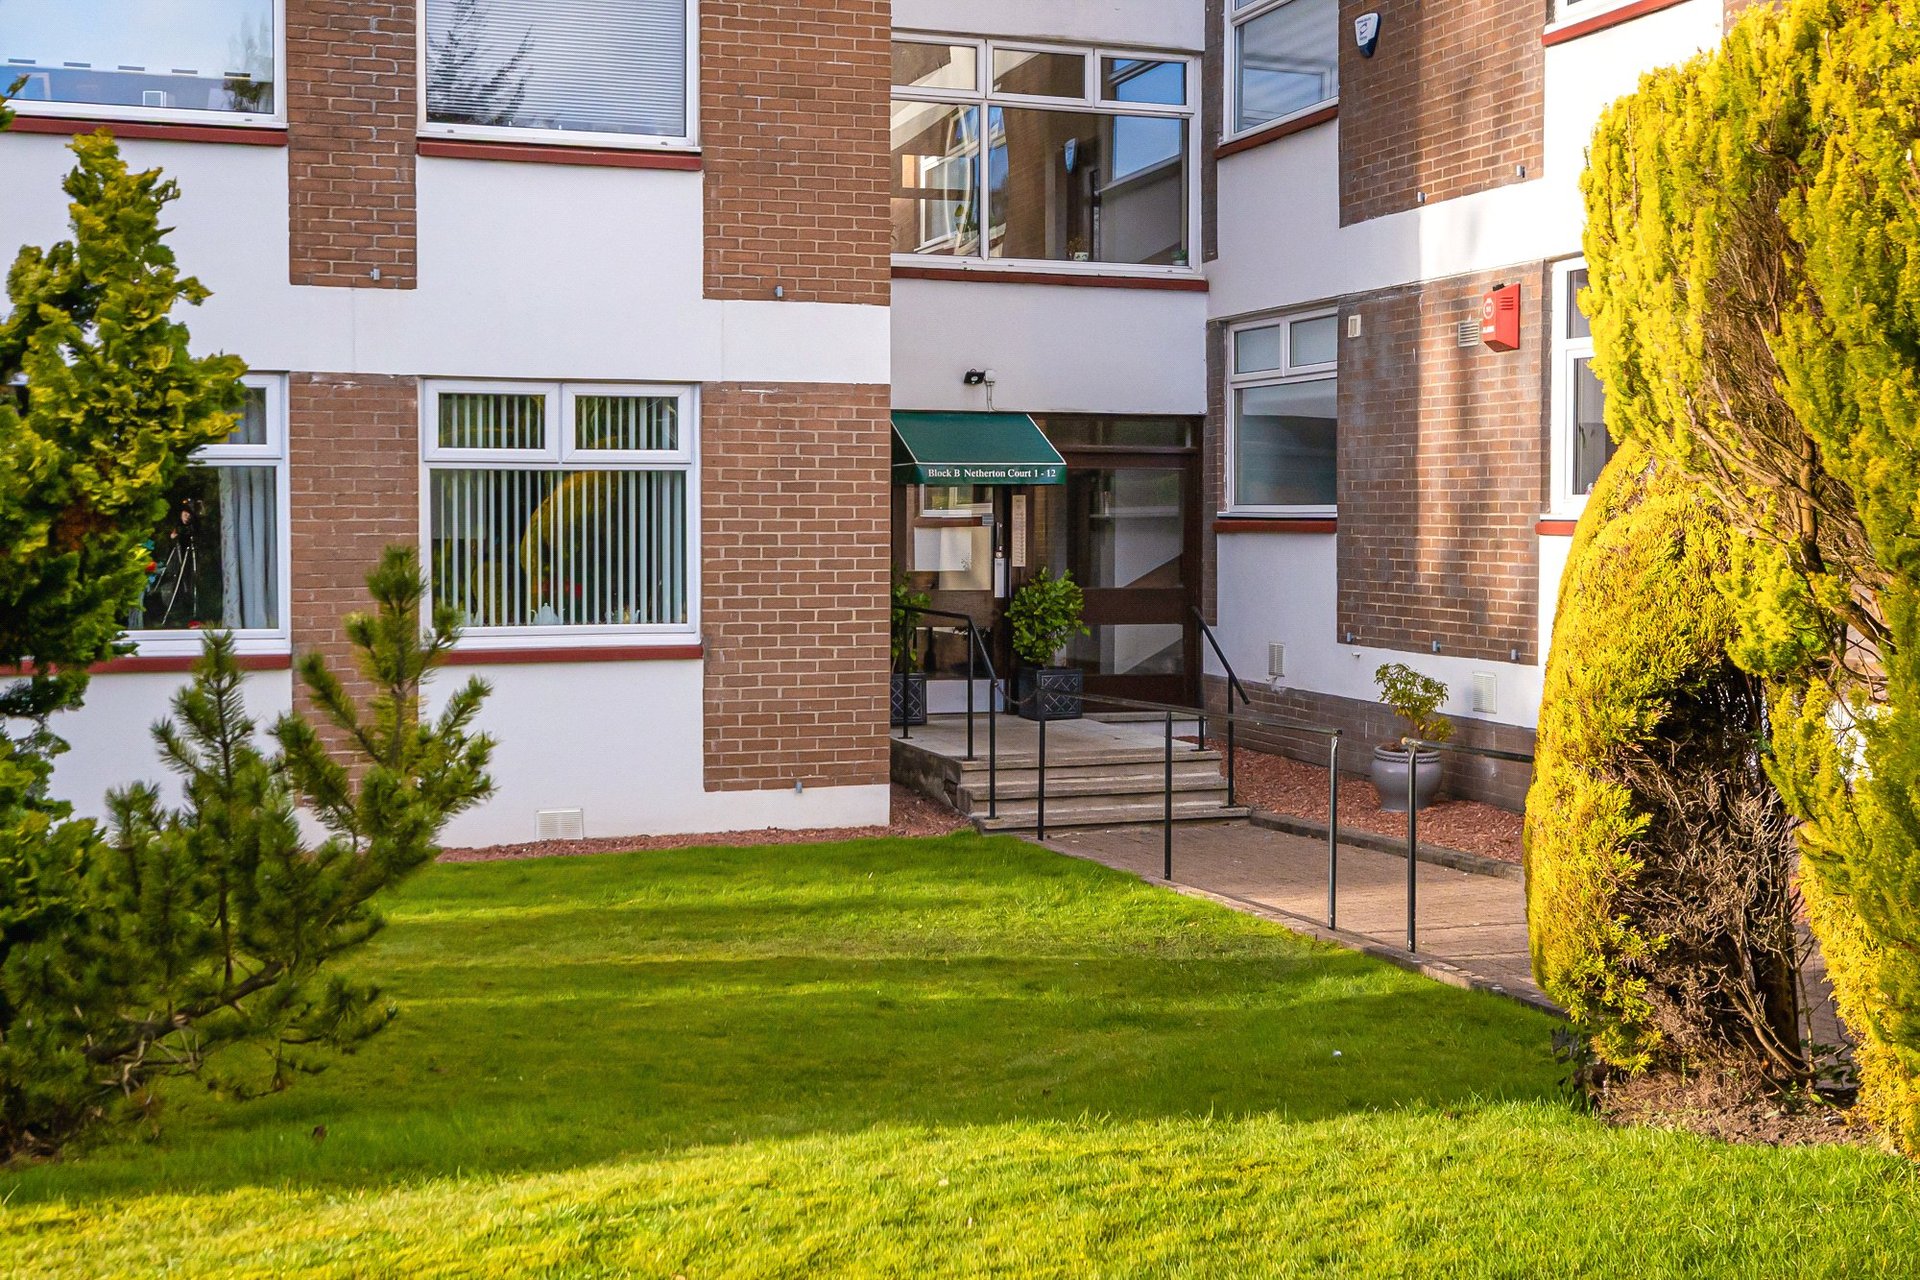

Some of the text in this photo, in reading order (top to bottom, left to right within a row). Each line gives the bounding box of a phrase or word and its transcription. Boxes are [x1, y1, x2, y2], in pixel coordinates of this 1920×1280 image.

[928, 469, 952, 478] Block
[954, 469, 960, 477] B
[964, 469, 1006, 478] Netherton
[1007, 469, 1032, 478] Court
[1046, 469, 1056, 478] 12
